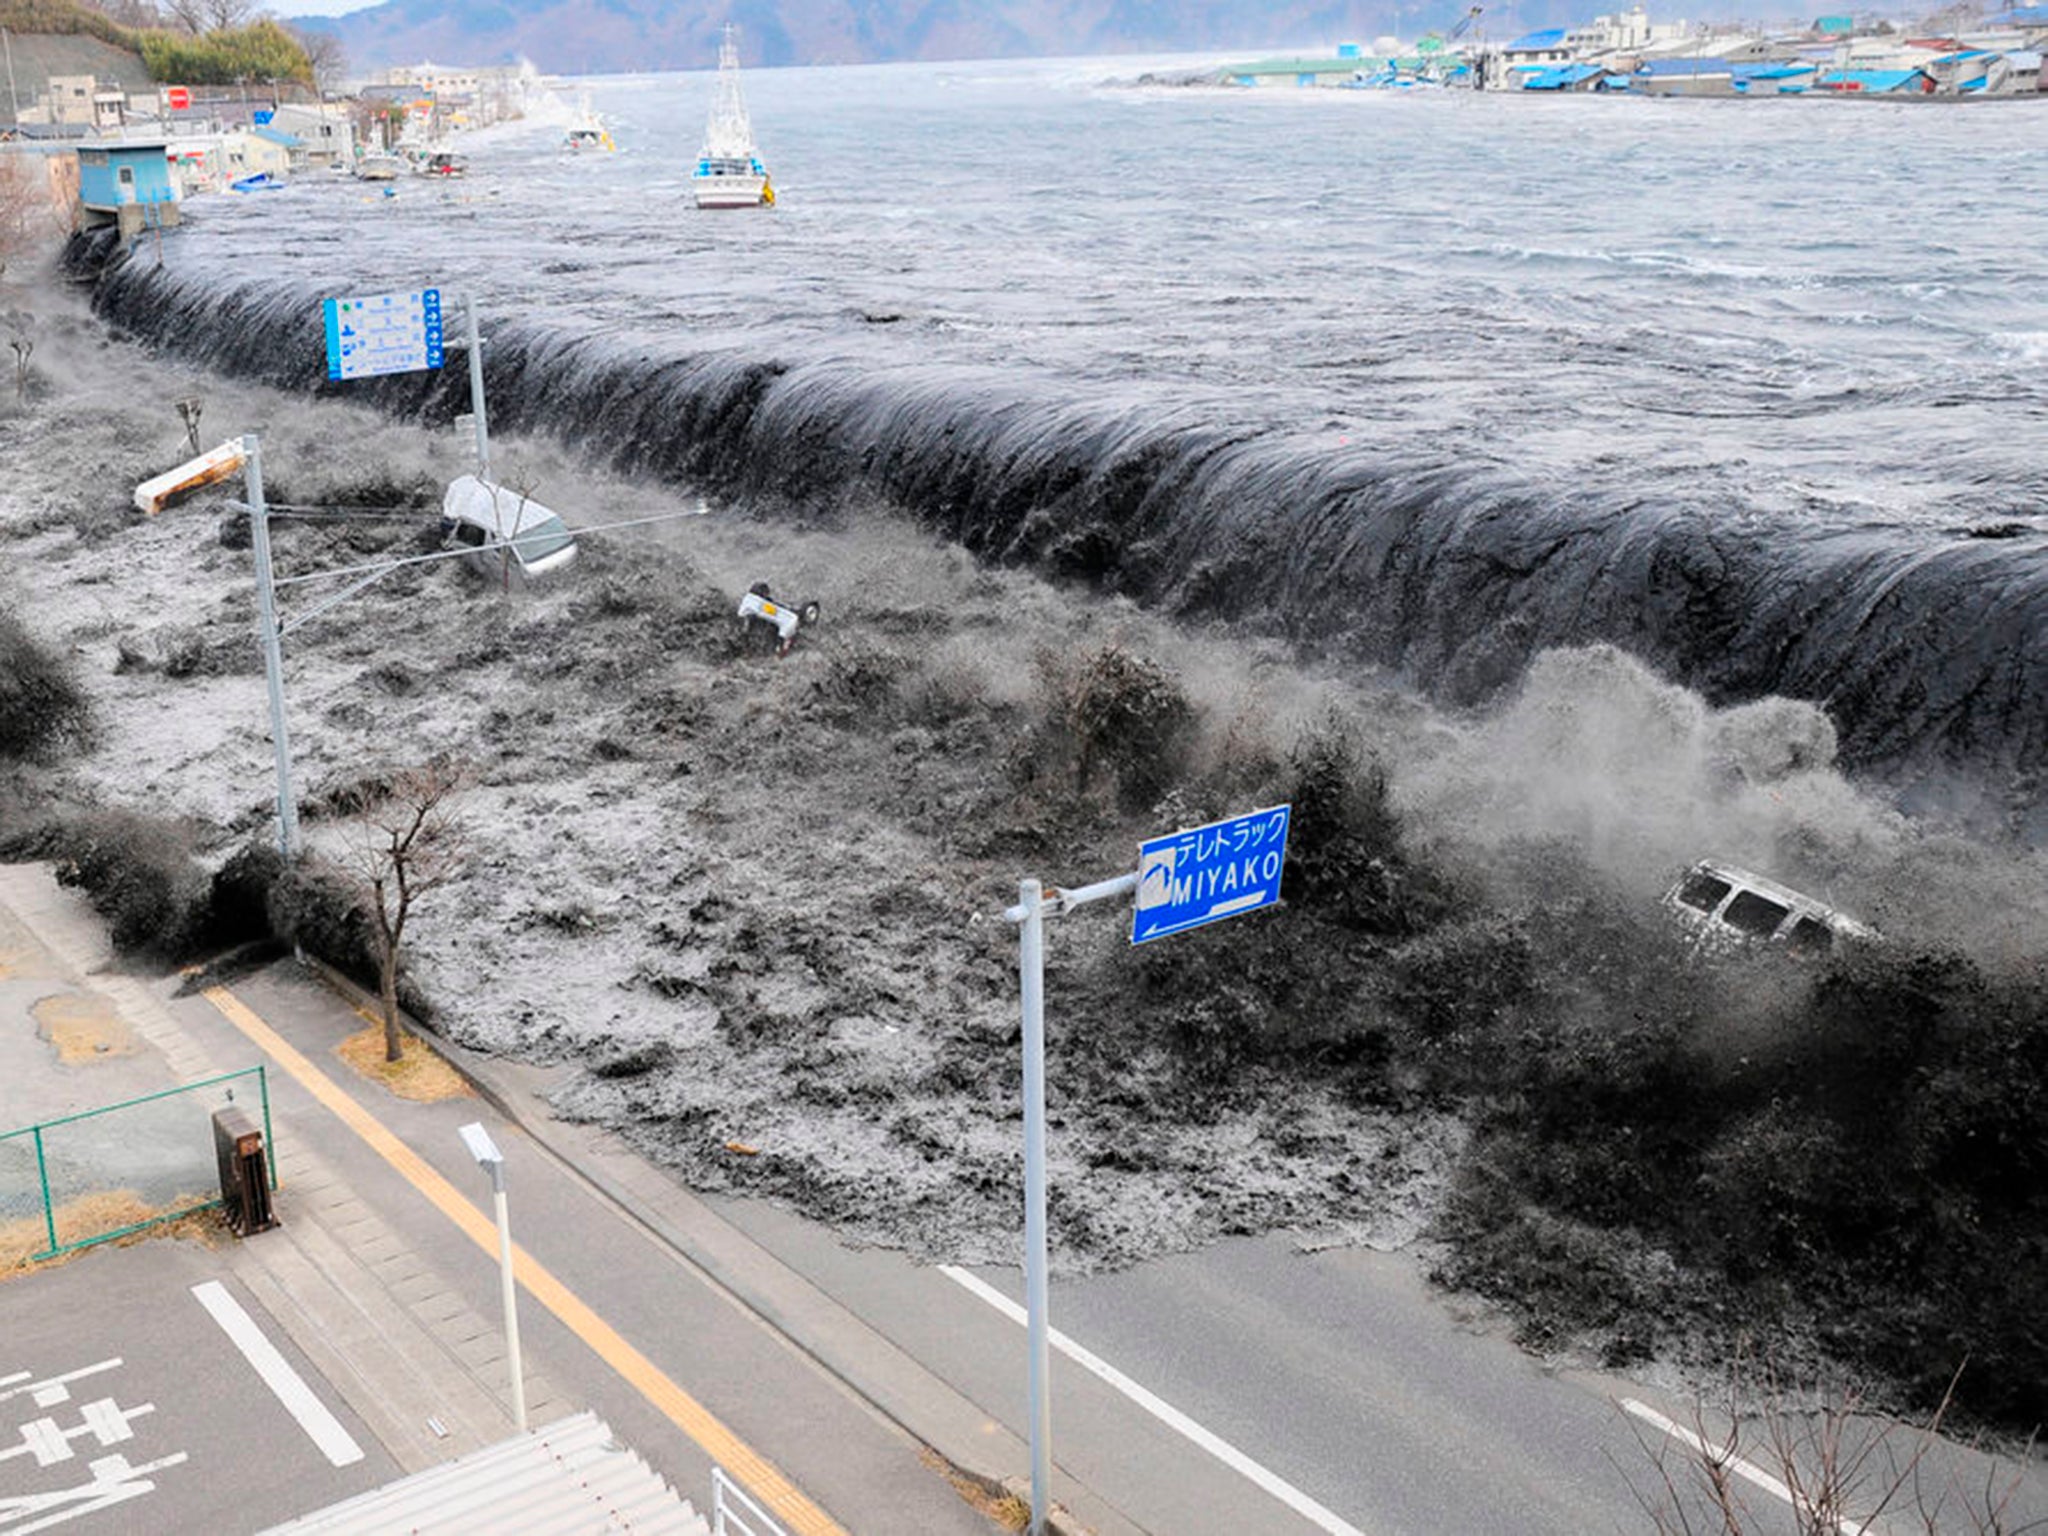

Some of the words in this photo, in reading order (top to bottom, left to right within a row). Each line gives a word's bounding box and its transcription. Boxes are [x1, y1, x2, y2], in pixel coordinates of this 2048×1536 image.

[1177, 812, 1285, 868] テレトラック
[1172, 850, 1279, 907] MIYAKO
